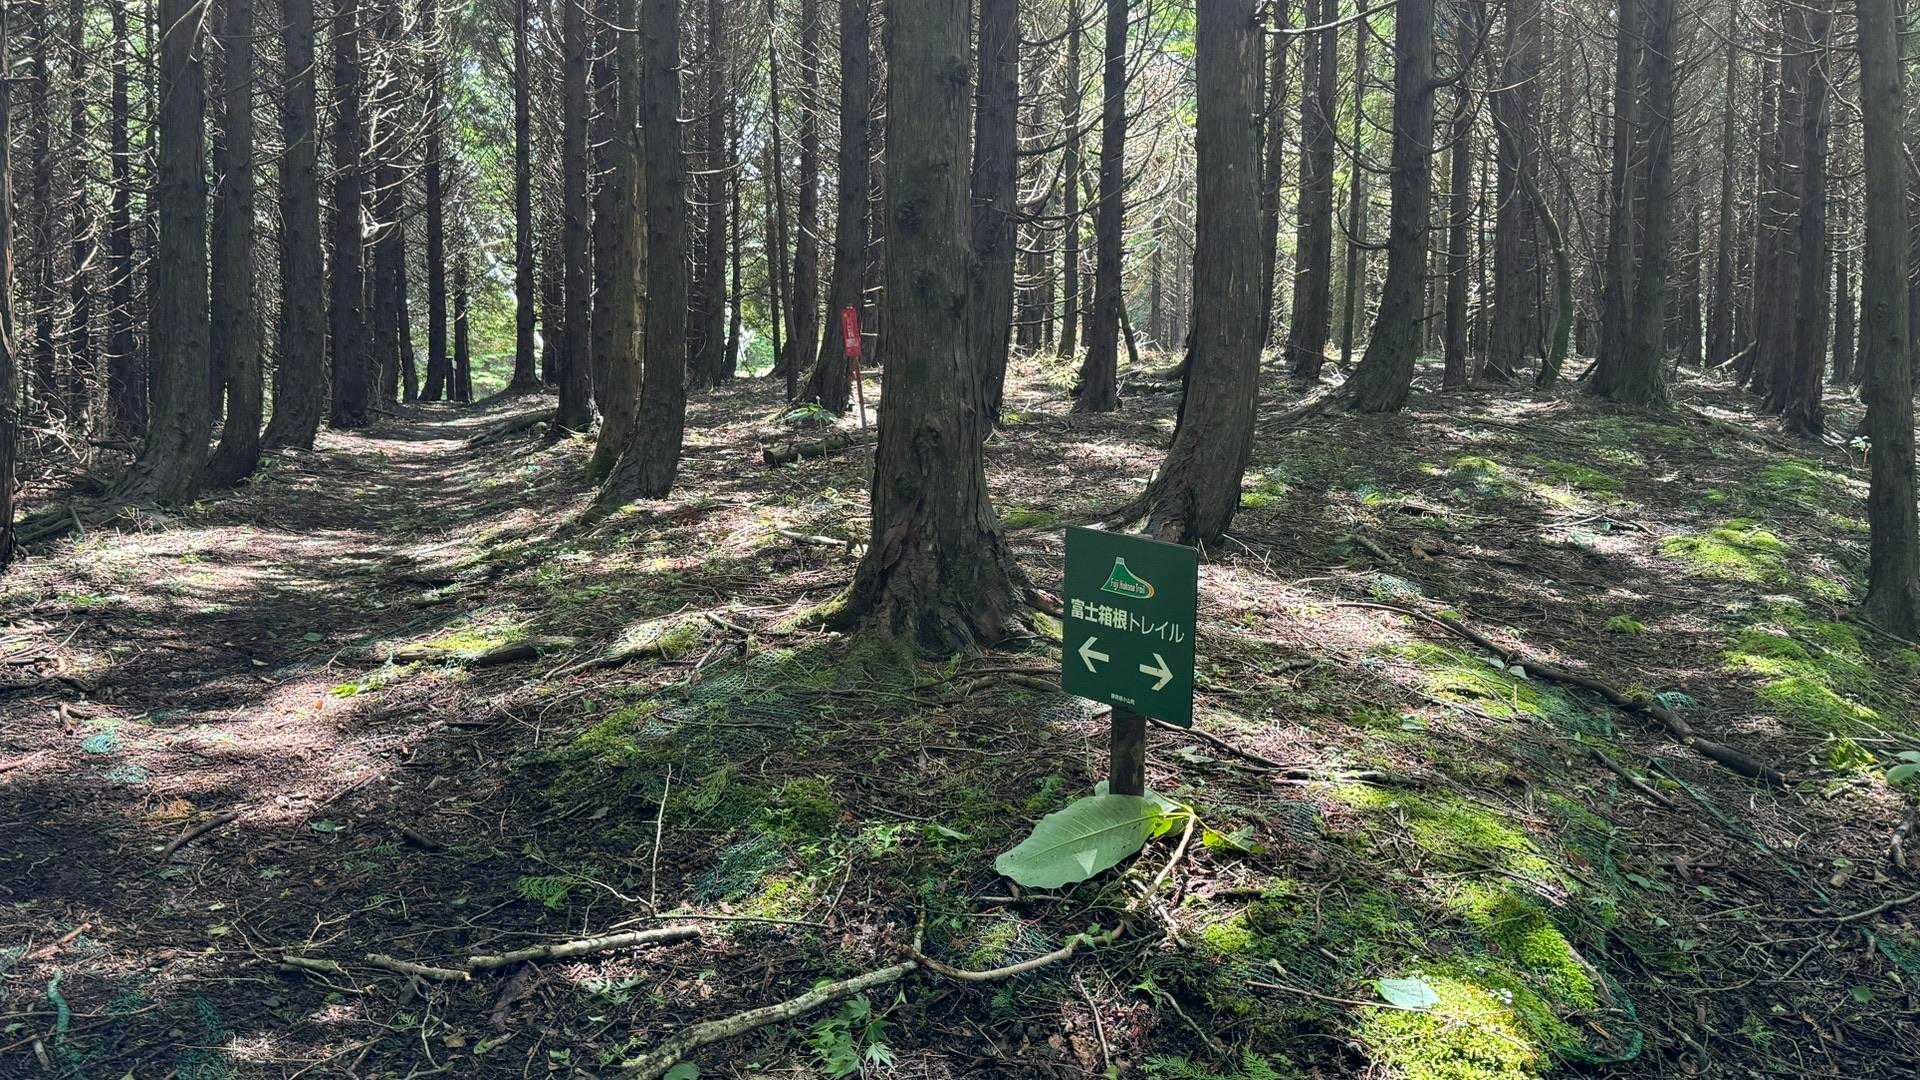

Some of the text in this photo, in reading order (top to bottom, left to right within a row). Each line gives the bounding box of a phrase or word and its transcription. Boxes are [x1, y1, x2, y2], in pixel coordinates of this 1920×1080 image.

[1071, 598, 1185, 643] 富士箱根トレイル
